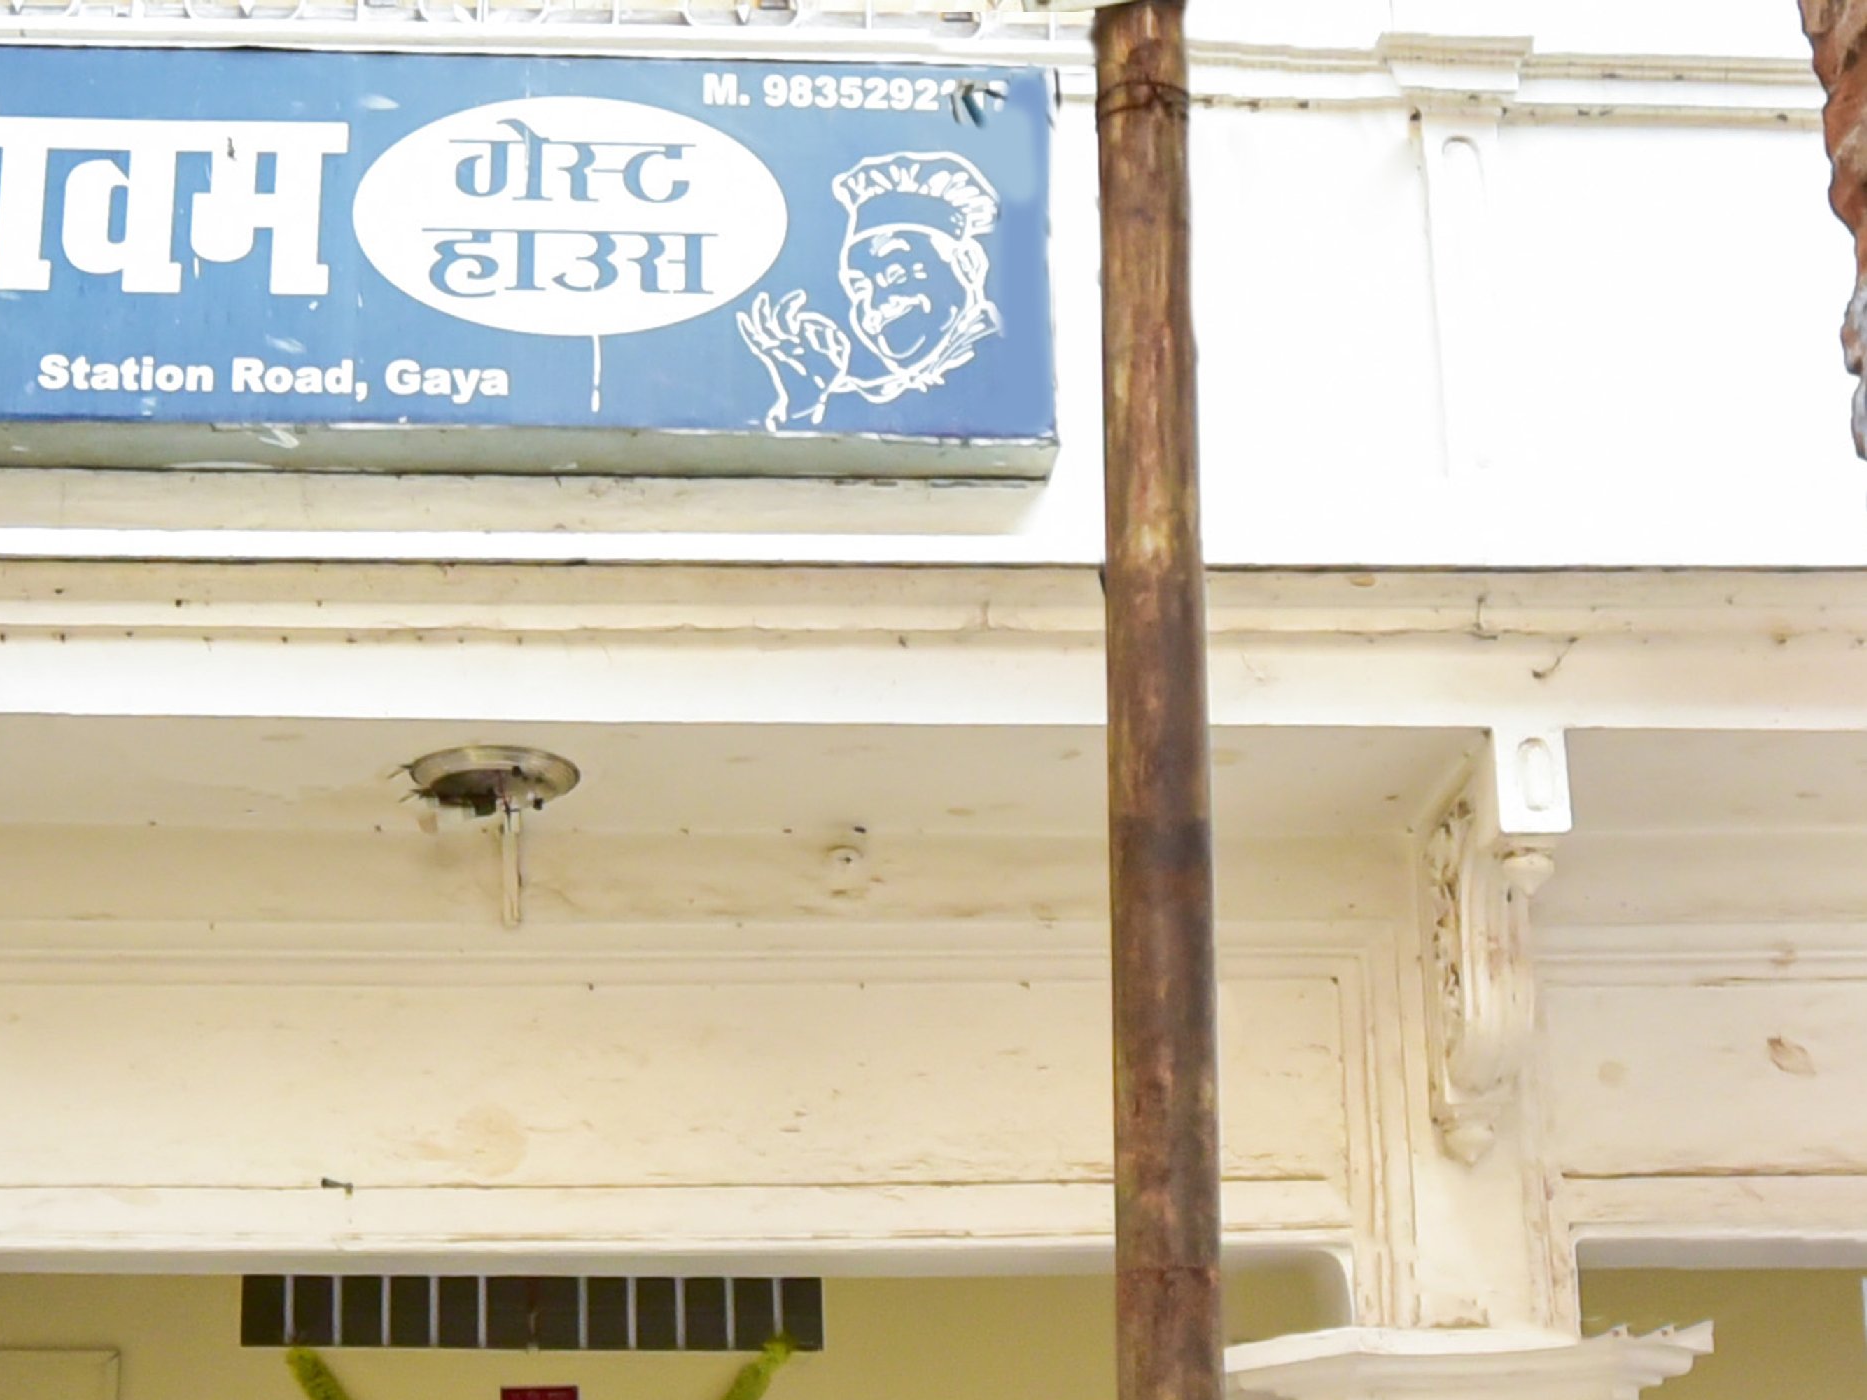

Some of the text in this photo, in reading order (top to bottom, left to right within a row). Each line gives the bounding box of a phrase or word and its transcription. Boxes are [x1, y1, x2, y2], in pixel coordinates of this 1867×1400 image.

[702, 73, 750, 107] M.
[449, 118, 696, 203] गेस्ट
[422, 228, 719, 297] हाउस
[38, 353, 509, 403] Station Road, Gaya
